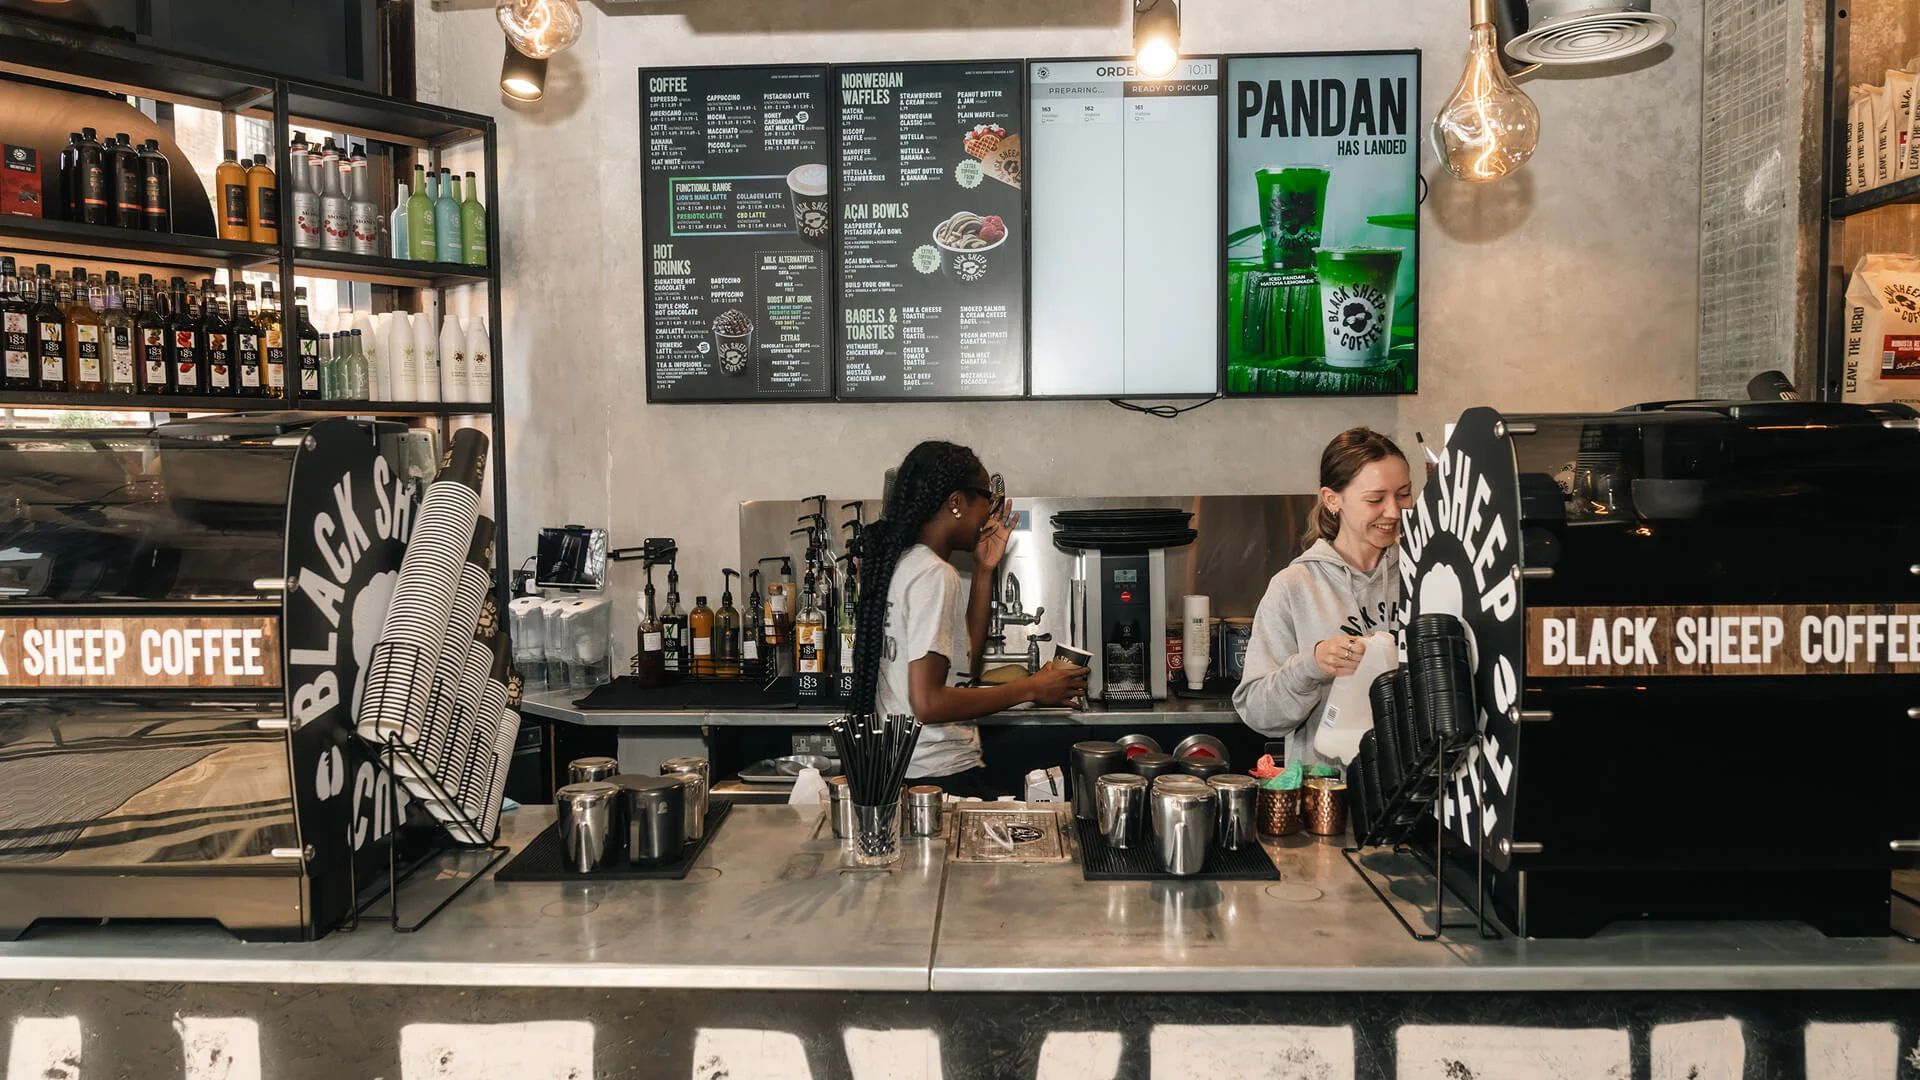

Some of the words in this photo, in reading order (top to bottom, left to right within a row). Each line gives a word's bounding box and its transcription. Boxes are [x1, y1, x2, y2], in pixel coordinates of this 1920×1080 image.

[1096, 66, 1140, 77] ORDE
[1188, 64, 1212, 75] 10:11
[650, 77, 687, 93] COFFEE
[842, 72, 903, 88] NORWEGIAN
[842, 90, 890, 104] WAFFLES
[1238, 78, 1407, 138] PANDAN
[1338, 141, 1359, 155] HAS
[1364, 140, 1406, 155] LANDED
[1910, 144, 1920, 170] LEAVE
[676, 184, 710, 192] FUNCTIONAL
[712, 183, 732, 191] RANGE
[844, 204, 868, 222] AÇAI
[872, 204, 909, 218] BOWLS
[654, 244, 673, 259] HOT
[654, 261, 691, 275] DRINKS
[1329, 286, 1350, 322] BLACK
[1352, 283, 1385, 310] SHEEP
[845, 309, 884, 323] BAGELS
[890, 308, 897, 323] &
[1851, 307, 1864, 333] HERD
[846, 325, 894, 340] TOASTIES
[1341, 323, 1384, 351] COFFEE
[1848, 337, 1861, 357] THE
[1846, 361, 1858, 393] LEAVE
[1438, 446, 1516, 622] SHEEP
[290, 471, 371, 728] BLACK
[1543, 617, 1657, 666] BLACK
[1675, 616, 1784, 664] SHEEP
[1800, 615, 1920, 663] COFFEE
[23, 629, 126, 675] SHEEP
[140, 629, 264, 675] COFFEE
[799, 675, 817, 689] 183
[840, 676, 852, 690] 18
